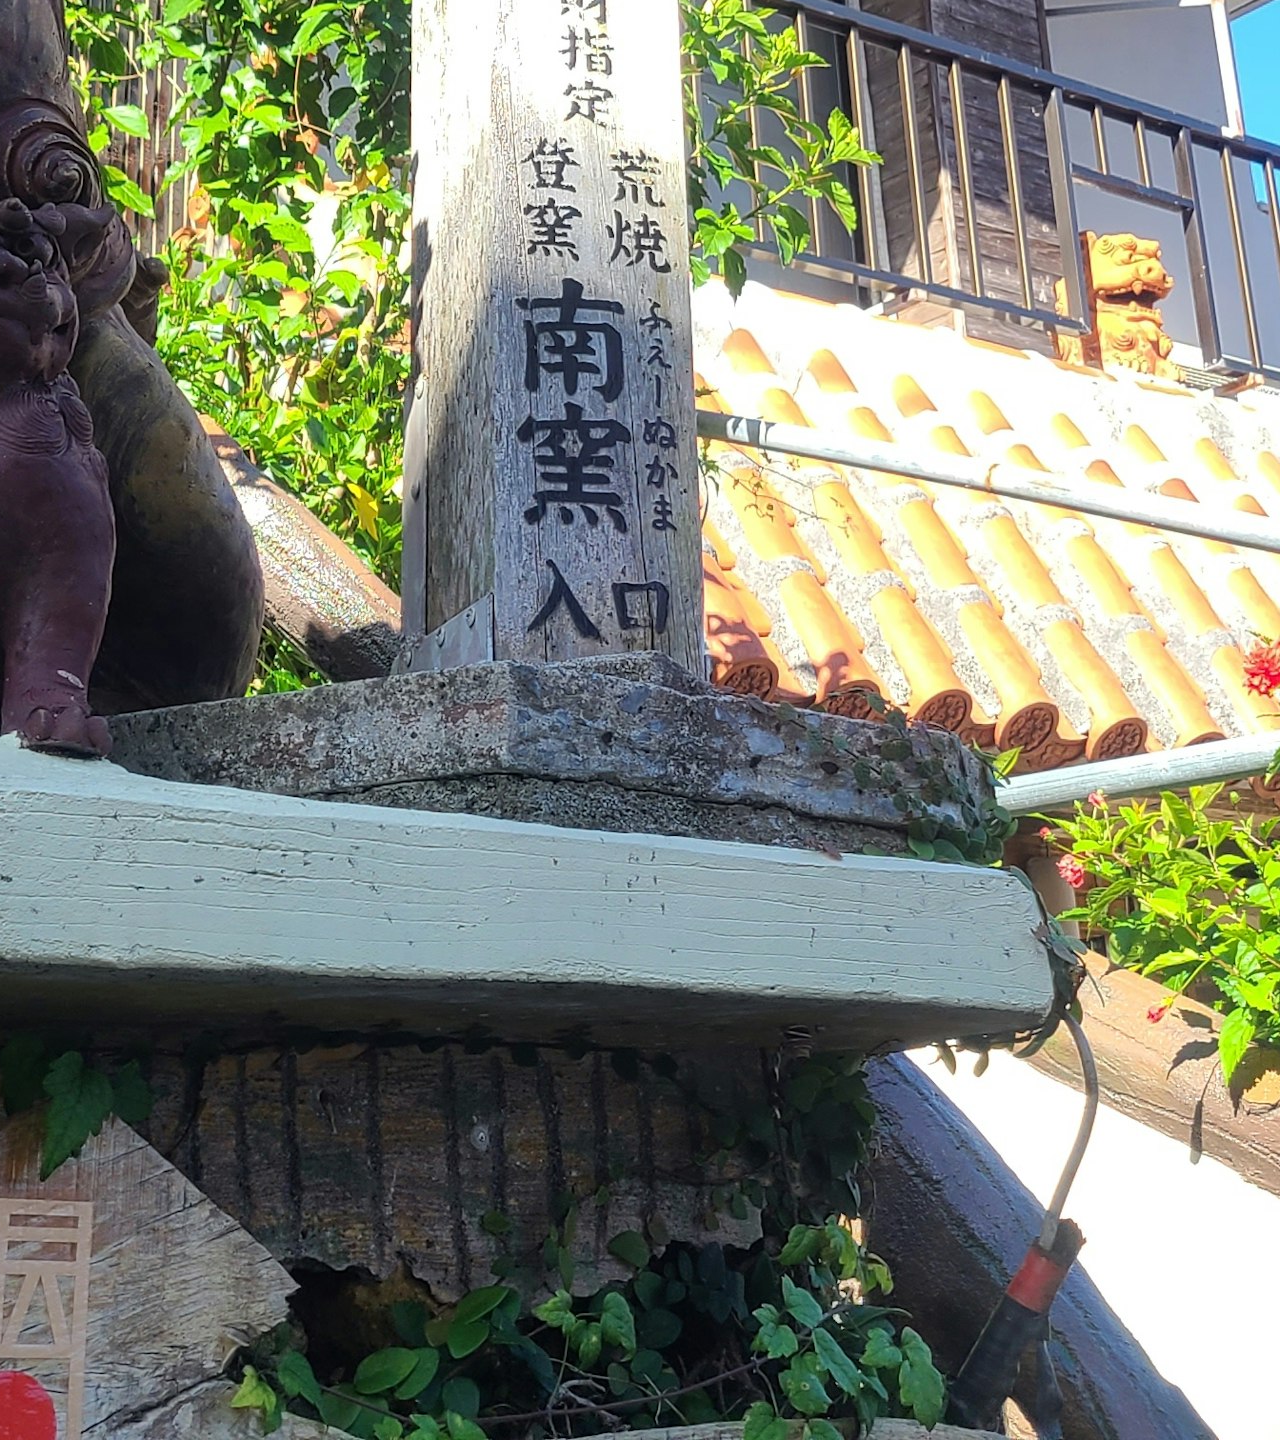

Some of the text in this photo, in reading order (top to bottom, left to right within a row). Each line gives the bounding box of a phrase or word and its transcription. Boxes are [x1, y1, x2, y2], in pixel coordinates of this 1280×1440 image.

[606, 149, 672, 273] 荒焼
[515, 277, 631, 534] 南窯
[526, 559, 670, 640] 入口
